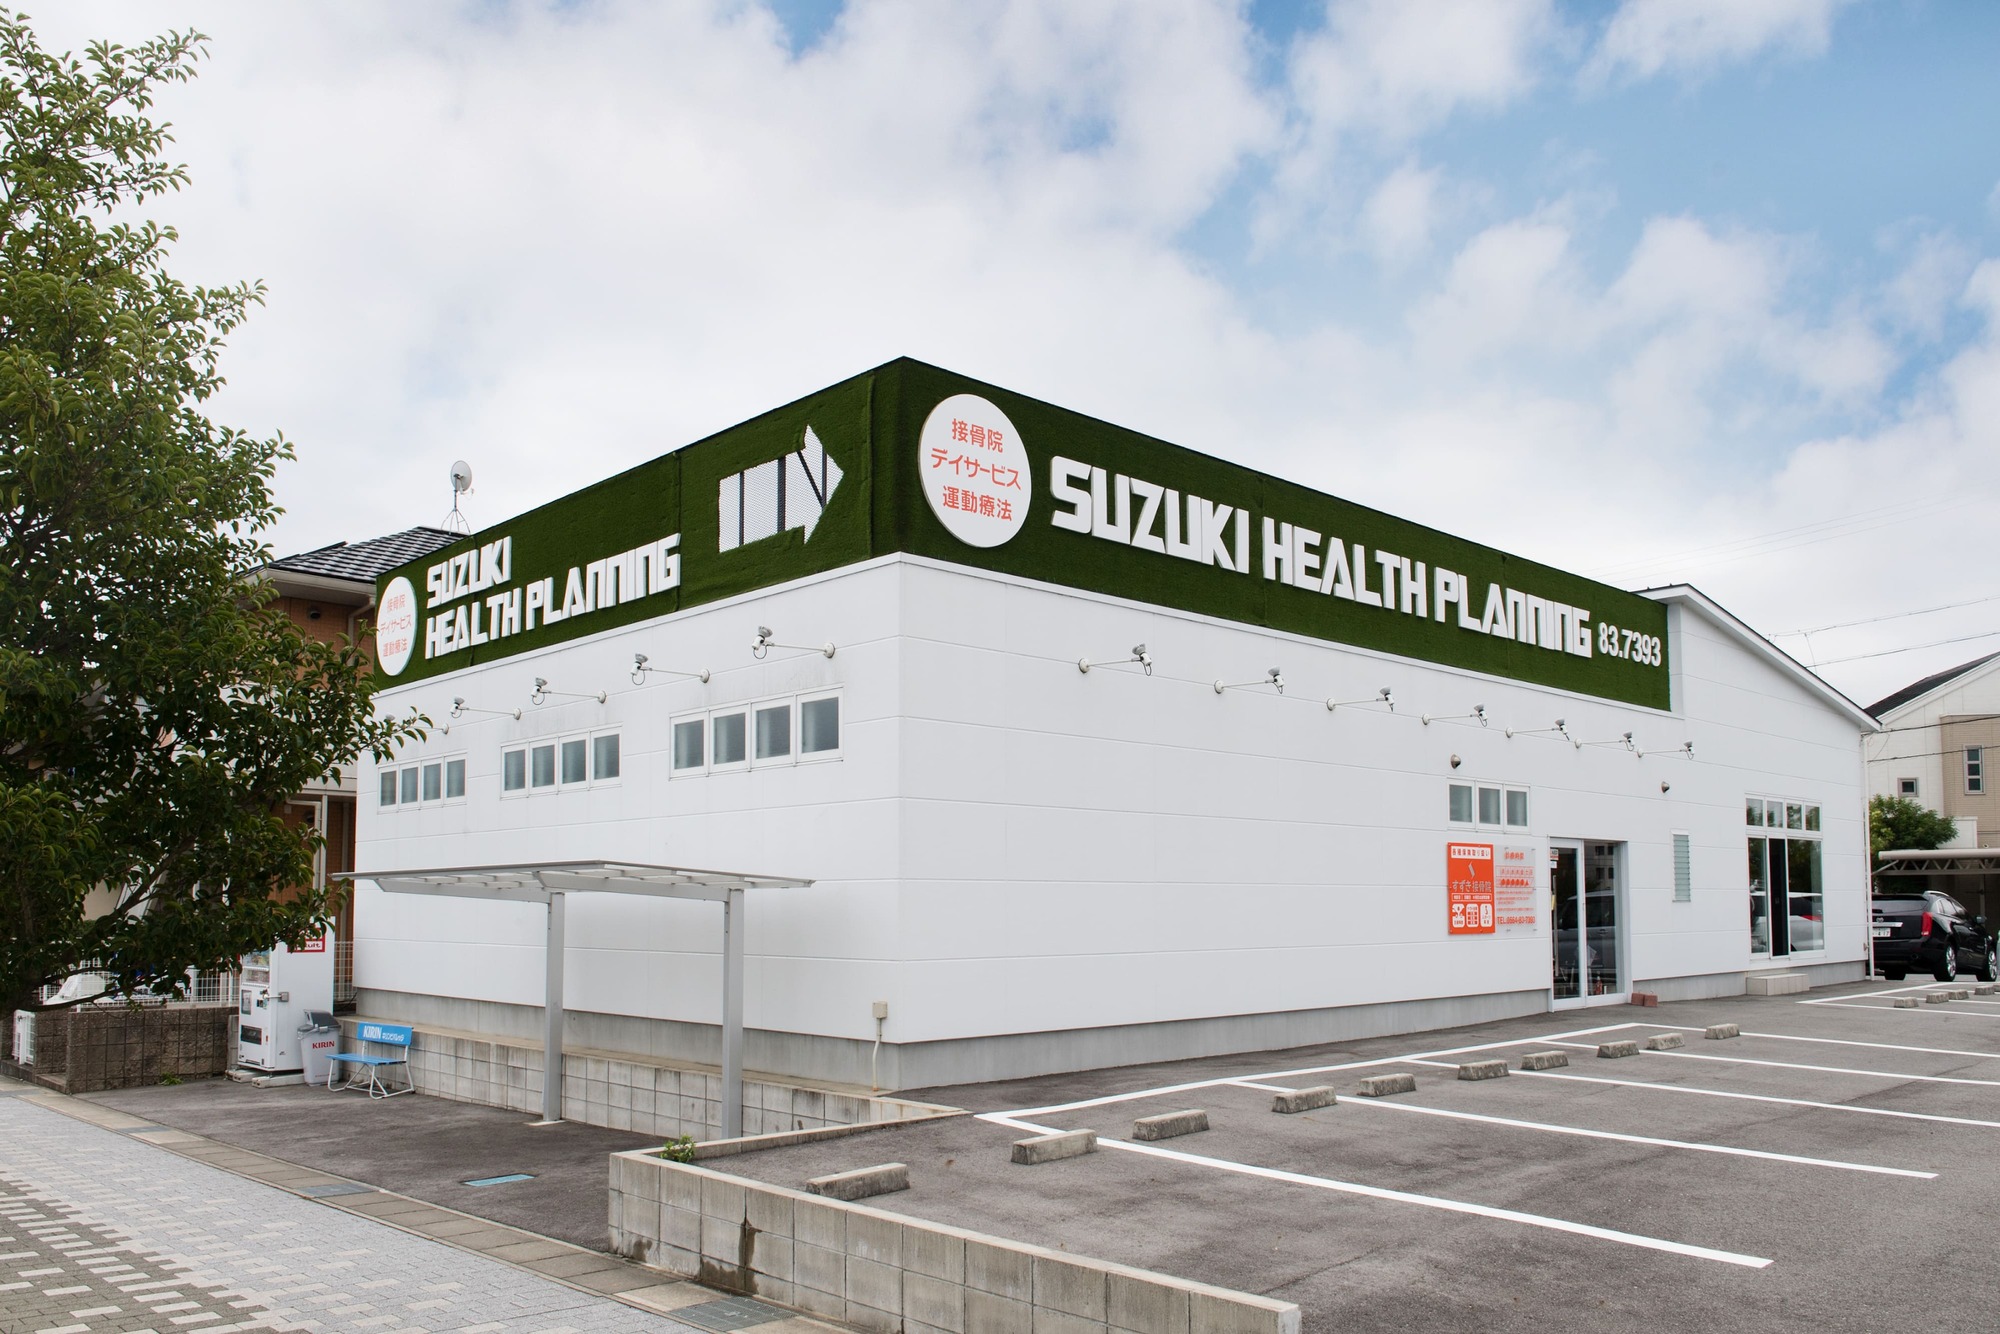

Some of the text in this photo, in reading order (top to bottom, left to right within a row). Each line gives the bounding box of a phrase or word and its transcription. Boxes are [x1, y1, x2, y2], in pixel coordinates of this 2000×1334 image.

[952, 418, 1003, 453] 接骨院
[931, 447, 1021, 490] デイサービス
[943, 485, 1012, 521] 運動療法
[427, 536, 512, 609] SUZUKI
[1051, 455, 1661, 667] SUZUKI HEALTH PLANNING 83.7393
[425, 533, 681, 659] HEALTH PLANNING
[380, 614, 412, 636] デイサービス
[312, 1040, 335, 1050] KIRIN
[363, 1024, 383, 1039] KIRIN
